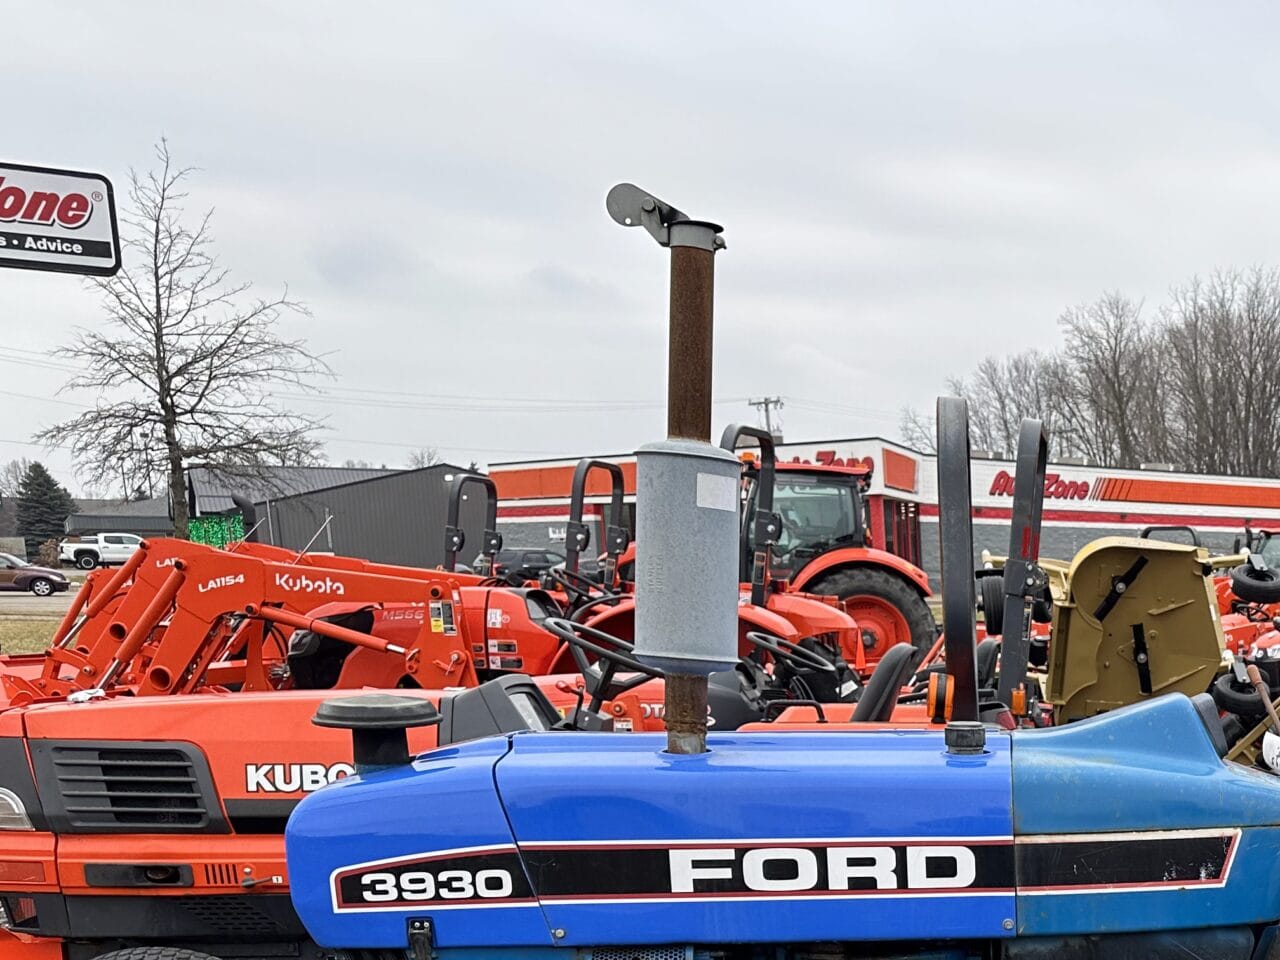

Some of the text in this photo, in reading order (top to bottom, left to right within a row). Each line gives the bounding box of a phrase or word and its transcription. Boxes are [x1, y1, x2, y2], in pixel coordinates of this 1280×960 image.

[0, 176, 93, 229] one
[25, 236, 83, 253] Advice
[989, 470, 1090, 500] AuZone
[198, 574, 245, 593] LA1154
[275, 573, 345, 596] Kubota
[382, 609, 425, 621] M566
[244, 762, 356, 794] KUBO
[360, 845, 976, 902] 3930 FORD
